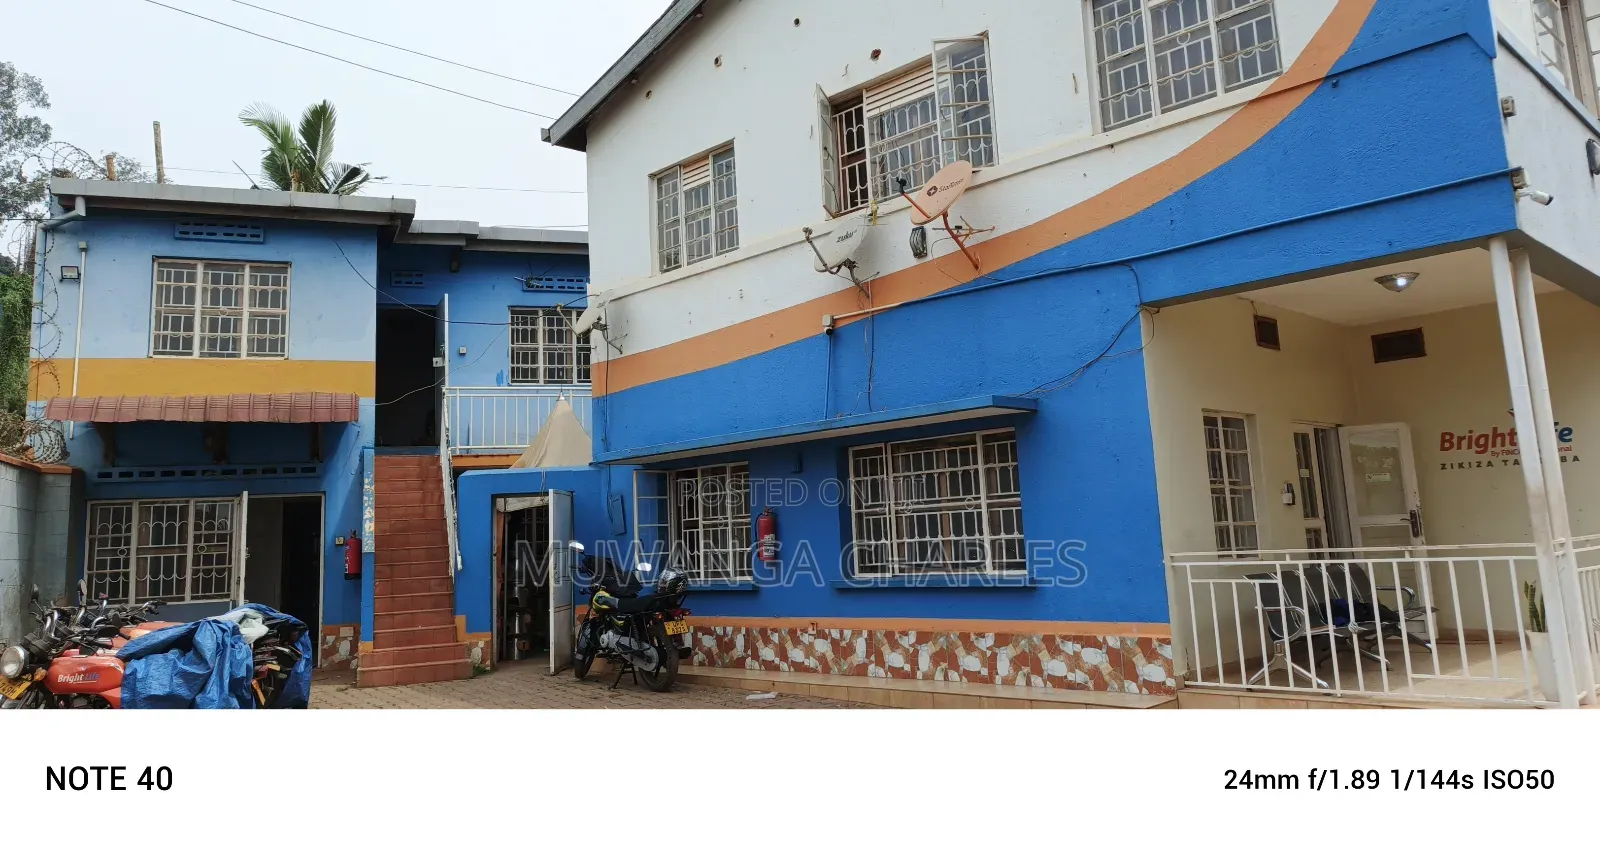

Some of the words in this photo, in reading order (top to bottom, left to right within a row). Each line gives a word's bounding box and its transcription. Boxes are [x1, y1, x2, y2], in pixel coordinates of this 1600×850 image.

[1440, 427, 1518, 454] Bright
[1440, 460, 1494, 470] ZIKIZA
[58, 673, 84, 684] Bright
